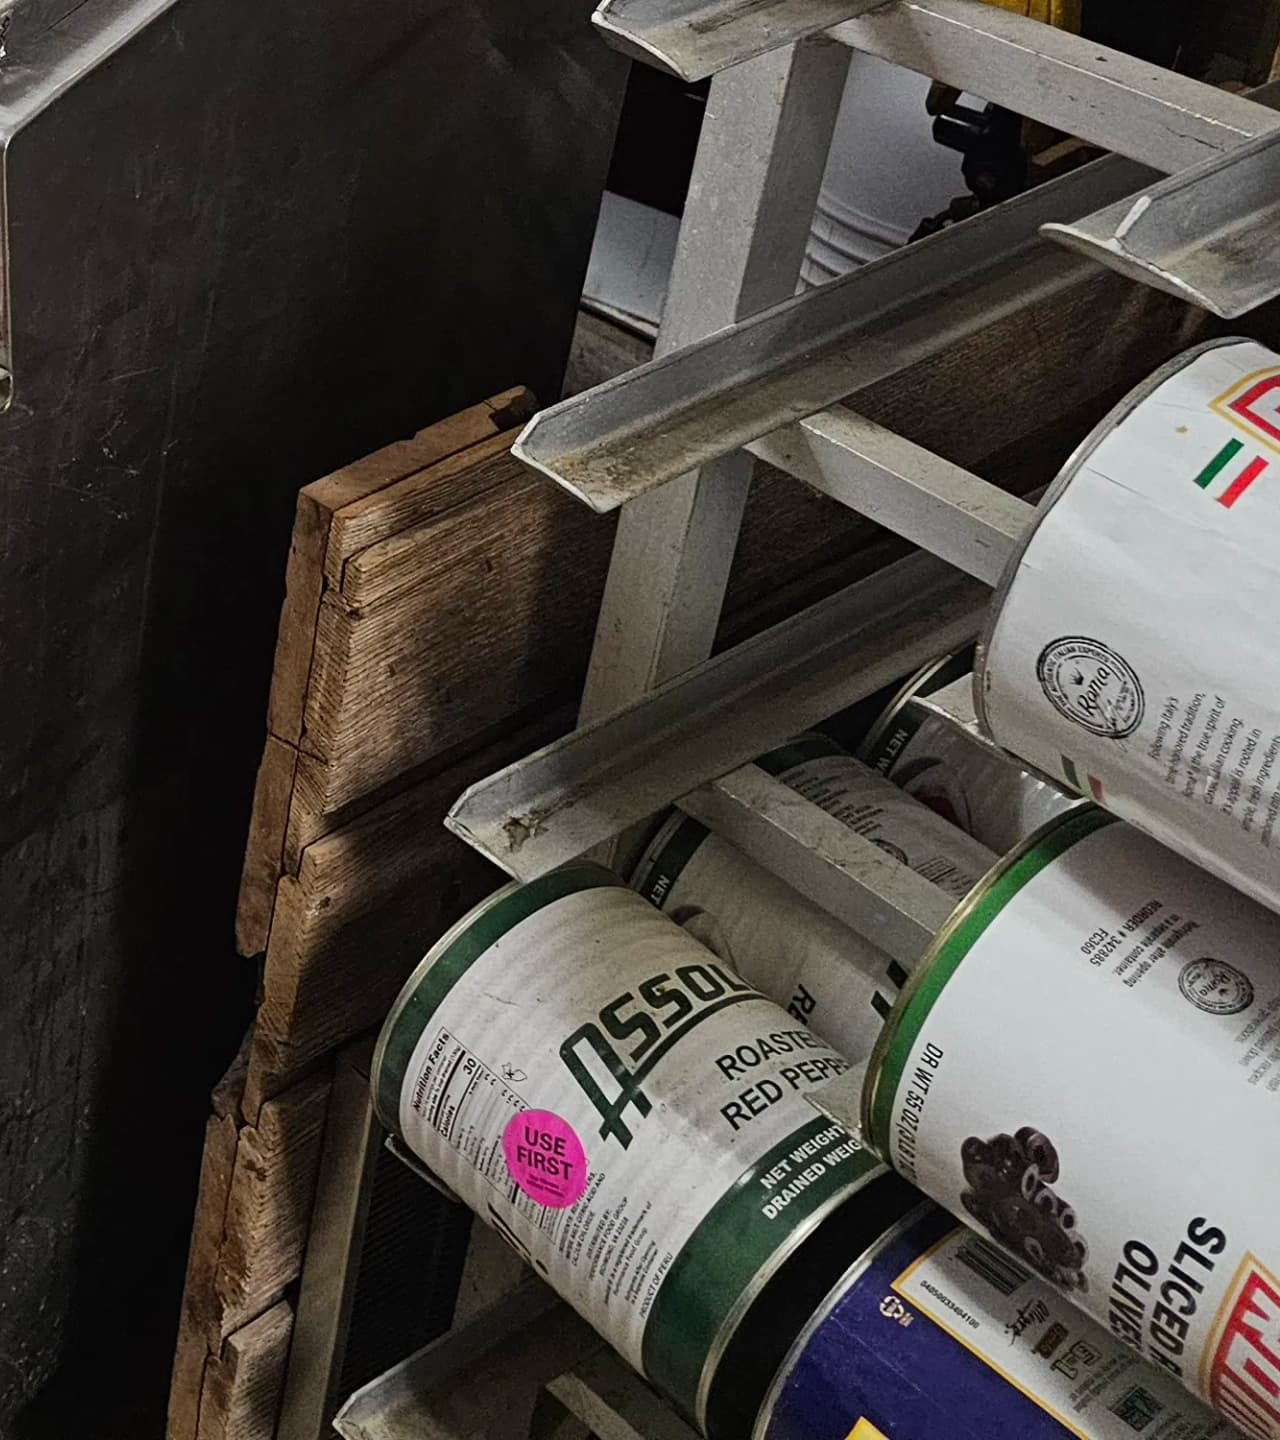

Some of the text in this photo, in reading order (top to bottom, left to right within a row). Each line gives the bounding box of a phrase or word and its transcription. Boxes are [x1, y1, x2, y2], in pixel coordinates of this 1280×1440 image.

[1053, 642, 1077, 661] ITALIAN
[1076, 663, 1112, 717] Roma
[1180, 689, 1207, 732] tradition,
[1198, 730, 1212, 752] true
[1205, 705, 1223, 735] spirit
[1214, 694, 1225, 709] of
[883, 728, 908, 756] NET
[1238, 736, 1257, 770] rooted
[1251, 725, 1262, 740] in
[647, 874, 670, 903] NET
[1121, 896, 1162, 936] REORDER
[1079, 925, 1108, 955] FC360
[1087, 934, 1119, 969] 342885
[1147, 944, 1166, 965] after
[1110, 943, 1144, 979] container.
[1122, 957, 1152, 990] opening
[1198, 970, 1230, 998] Roma
[785, 984, 817, 1024] RE
[412, 1064, 432, 1112] Nutrition
[427, 1031, 450, 1064] Facts
[714, 1030, 819, 1081] ROASTE
[918, 1042, 945, 1069] DR
[440, 1056, 478, 1137] Calories 30
[719, 1055, 849, 1132] RED PEPP
[908, 1067, 932, 1095] WT
[902, 1089, 925, 1112] 55
[898, 1107, 918, 1131] OZ
[523, 1124, 566, 1155] USE
[515, 1146, 573, 1180] FIRST
[593, 1171, 606, 1188] AND
[759, 1157, 793, 1191] NET
[761, 1136, 863, 1220] DRAINED WEIG
[639, 1251, 674, 1318] PRODUCT OF PERU
[1146, 1213, 1230, 1356] SLICED
